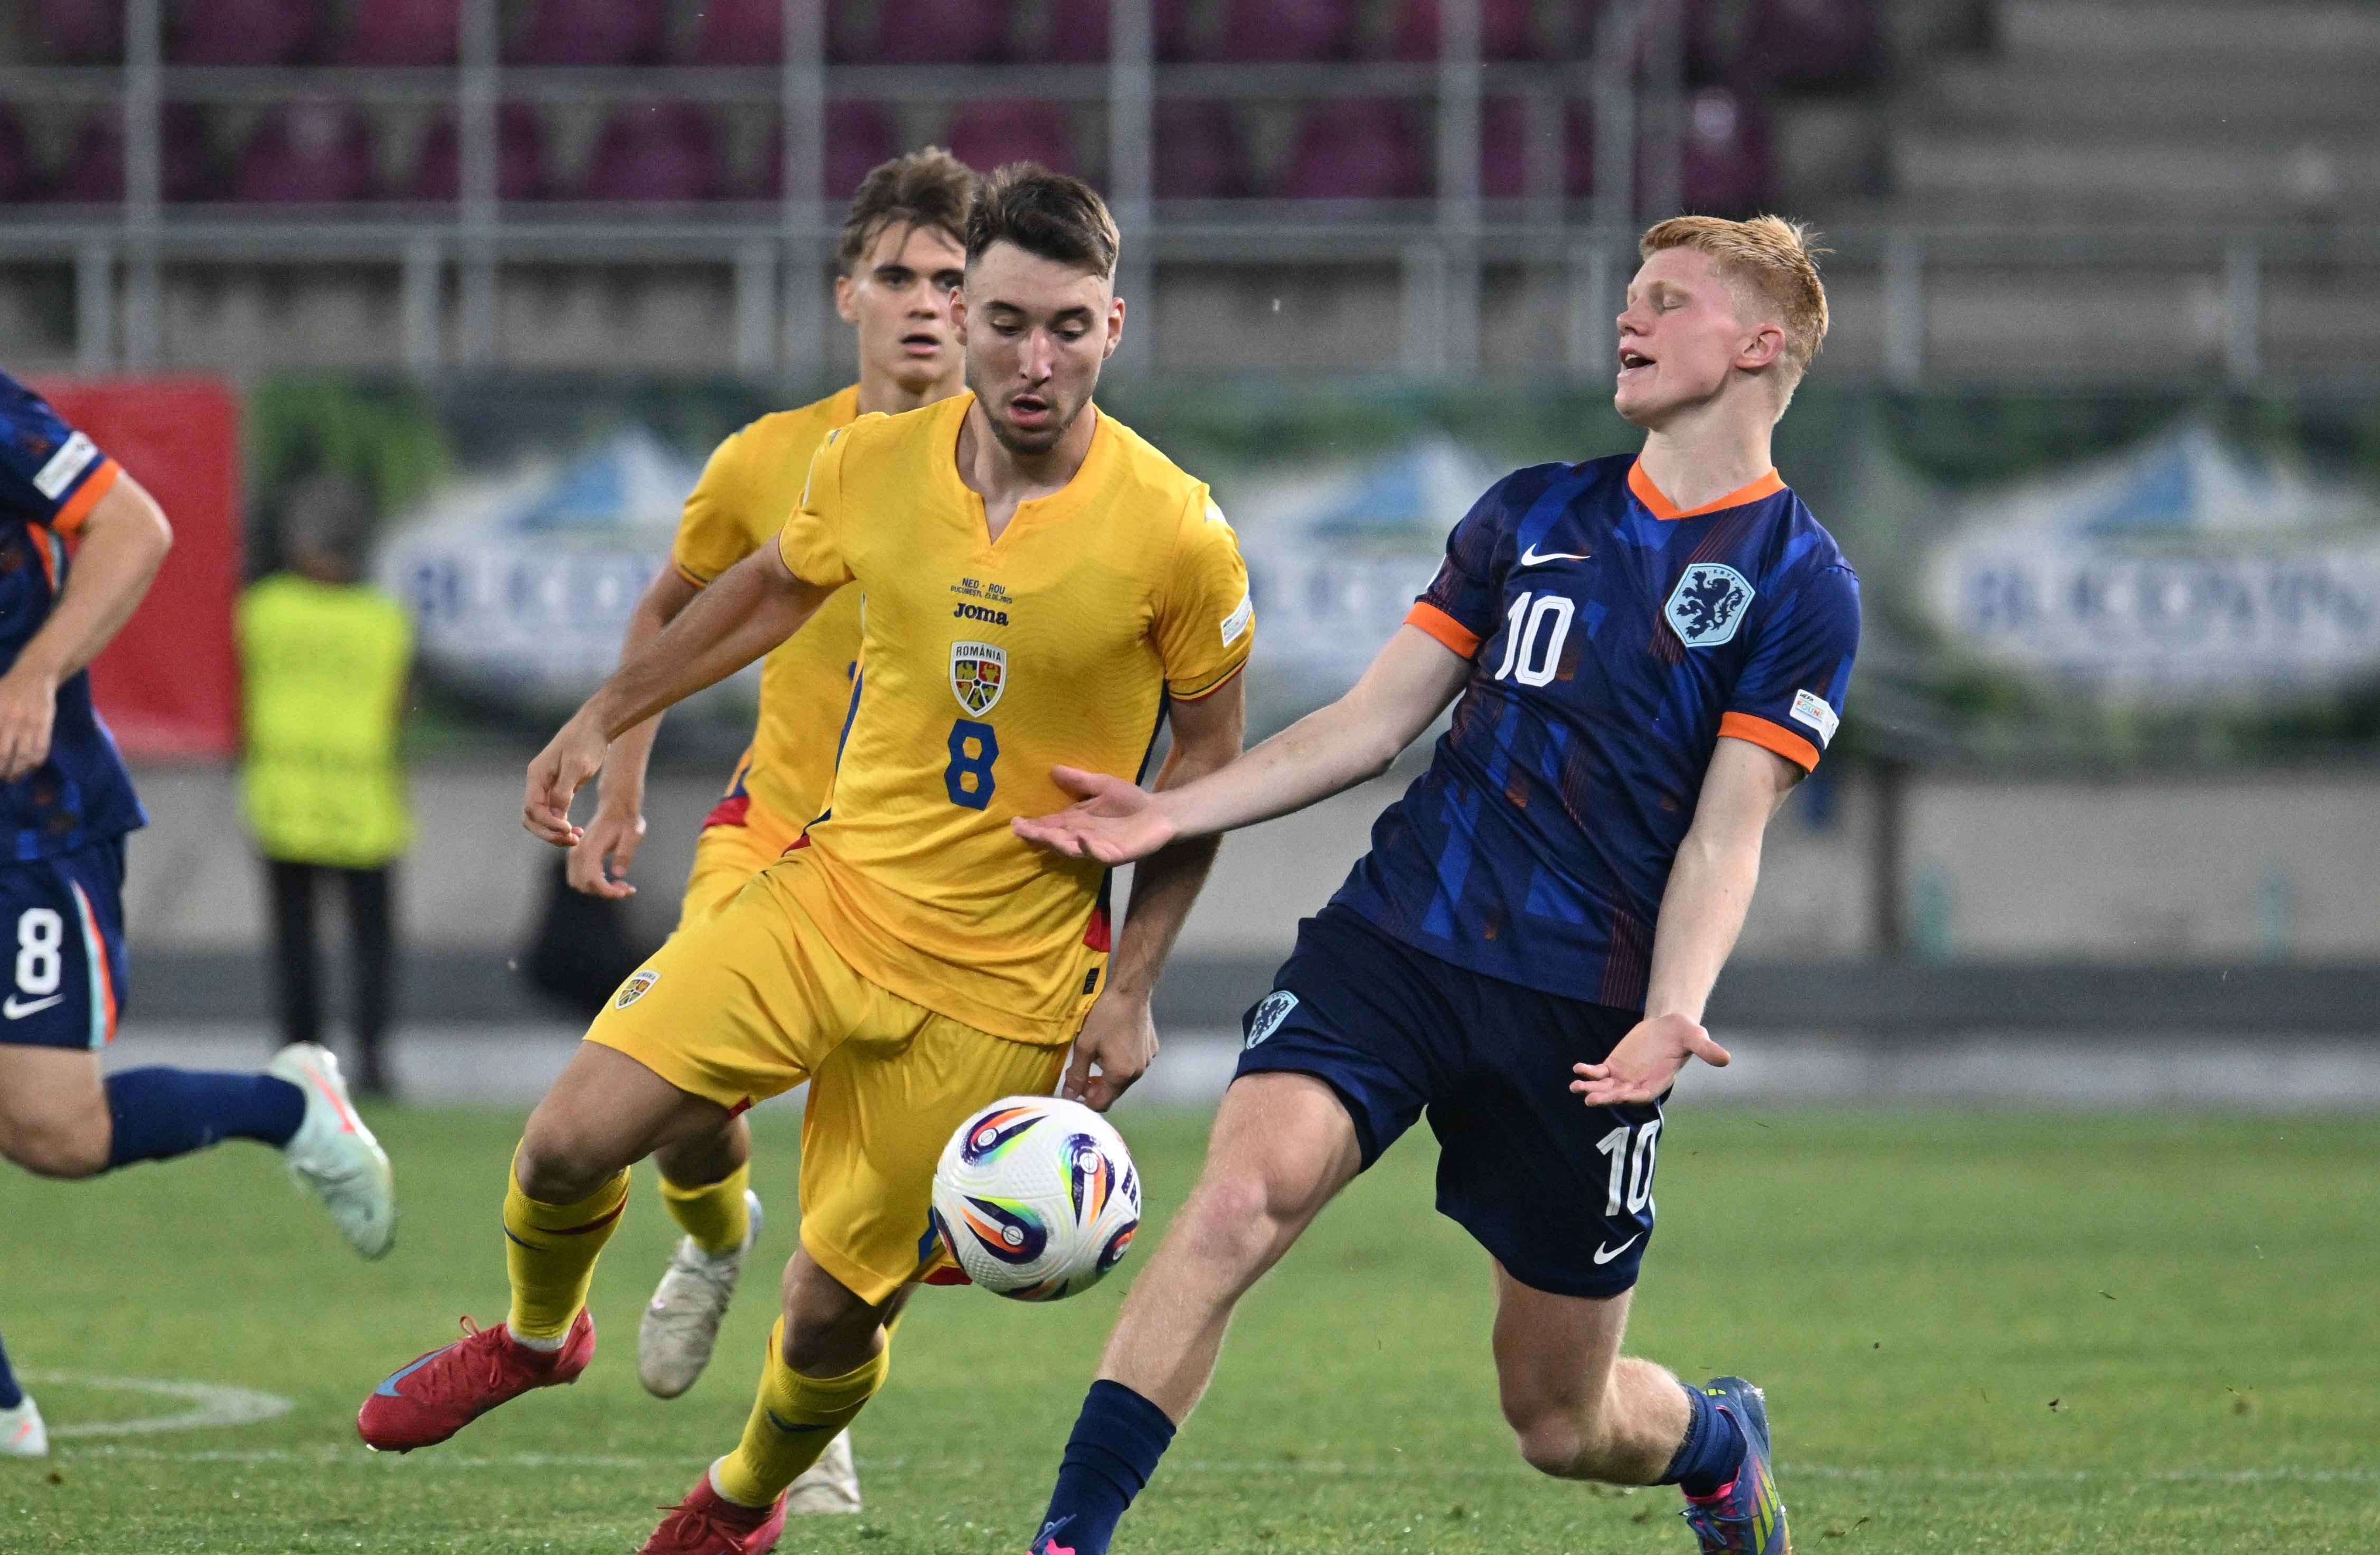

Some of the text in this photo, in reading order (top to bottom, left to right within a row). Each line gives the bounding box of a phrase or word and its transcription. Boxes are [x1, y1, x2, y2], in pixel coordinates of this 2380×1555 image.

[989, 583, 1005, 595] ROU
[956, 644, 1001, 662] ROMÂNIA
[1494, 592, 1576, 688] 10
[1799, 692, 1814, 702] UEFA
[944, 718, 1000, 811] 8
[15, 907, 63, 995] 8
[1595, 1119, 1661, 1217] 10
